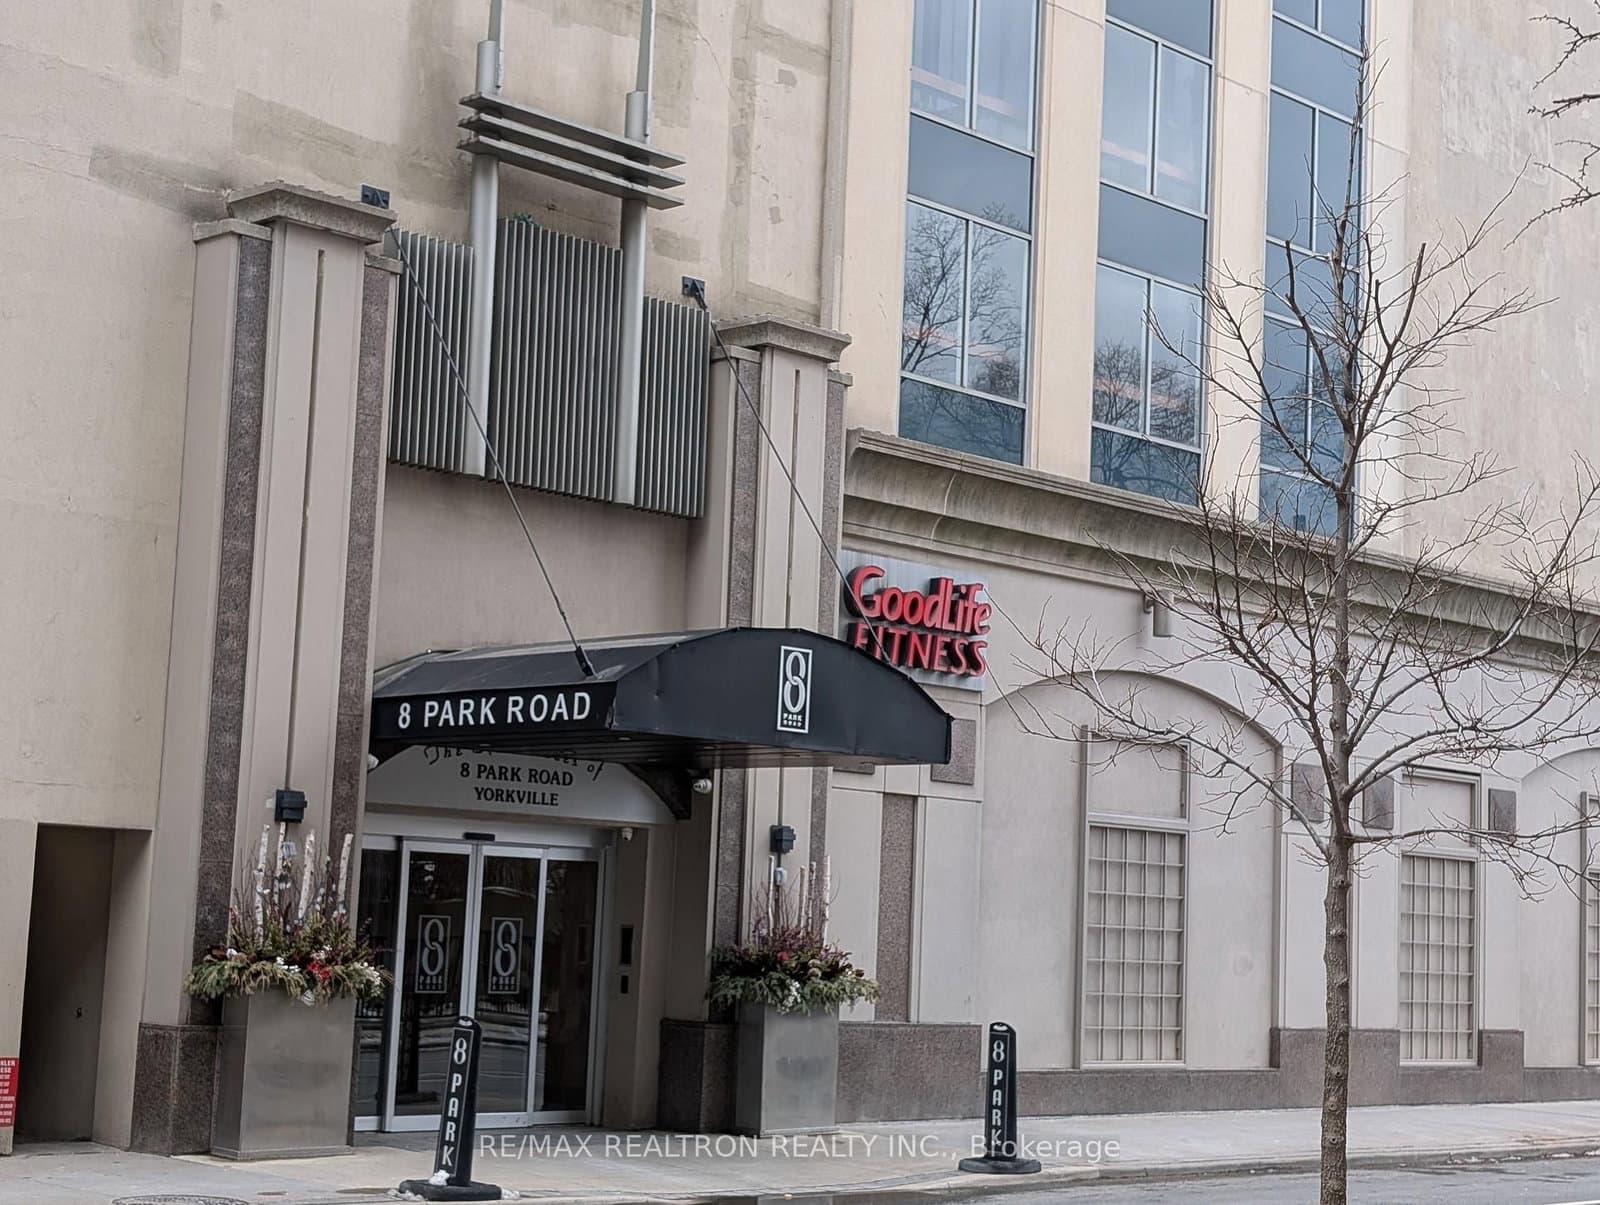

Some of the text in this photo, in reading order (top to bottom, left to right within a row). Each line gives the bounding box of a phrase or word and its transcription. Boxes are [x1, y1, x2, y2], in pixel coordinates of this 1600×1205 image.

[844, 565, 992, 635] GoodLife
[850, 622, 988, 677] FITNESS
[398, 692, 591, 729] 8 PARK ROAD
[783, 651, 806, 713] 8
[460, 762, 574, 786] 8 PARK ROAD
[474, 786, 559, 806] YORKVILLE
[441, 1037, 467, 1167] 8 PARK
[991, 1040, 1005, 1146] 8 PARK
